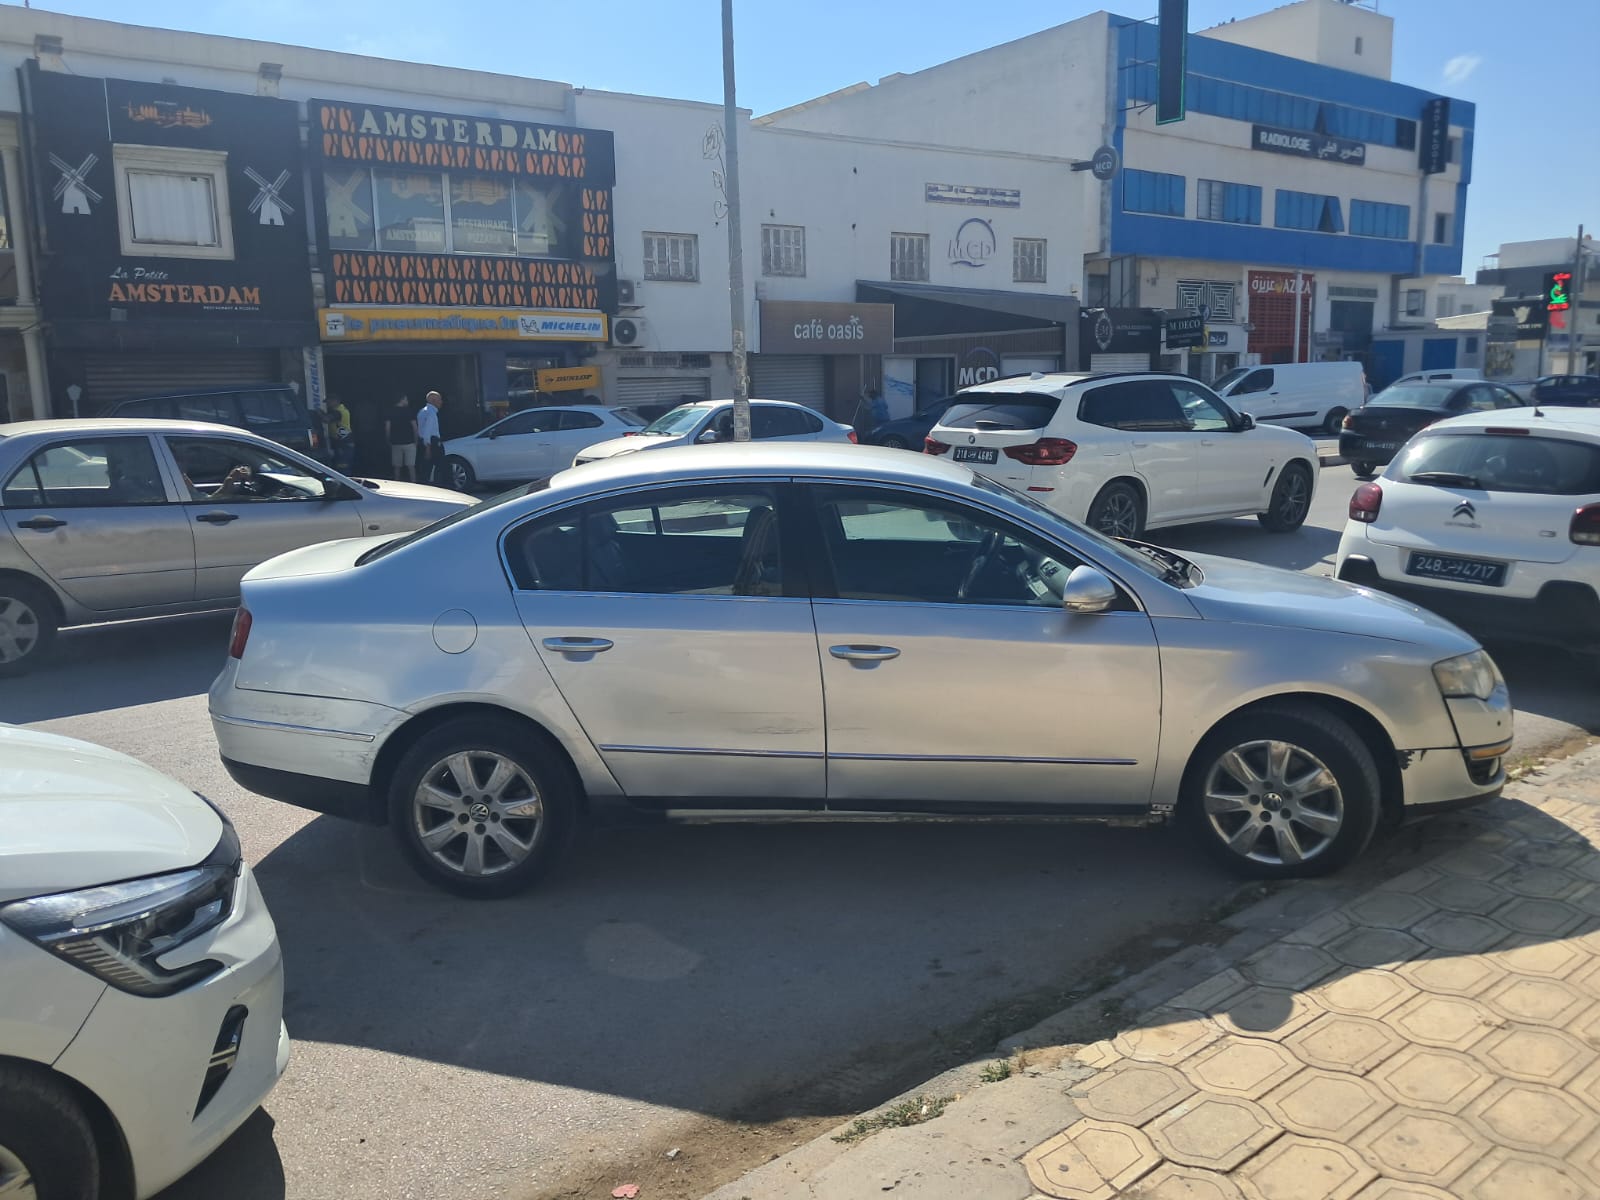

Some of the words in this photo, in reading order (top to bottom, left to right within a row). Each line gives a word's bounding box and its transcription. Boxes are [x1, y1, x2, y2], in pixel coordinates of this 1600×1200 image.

[359, 109, 557, 152] AMSTERDAM
[1260, 131, 1311, 152] RADIOLOGIE
[109, 266, 129, 279] La
[108, 282, 262, 305] AMSTERDAM
[541, 320, 601, 331] MICHELIN
[794, 318, 824, 339] café
[827, 318, 864, 340] oasis
[556, 374, 593, 383] DUNLOP
[959, 366, 999, 385] MCD
[1416, 556, 1442, 572] 248
[1463, 563, 1497, 579] 4717
